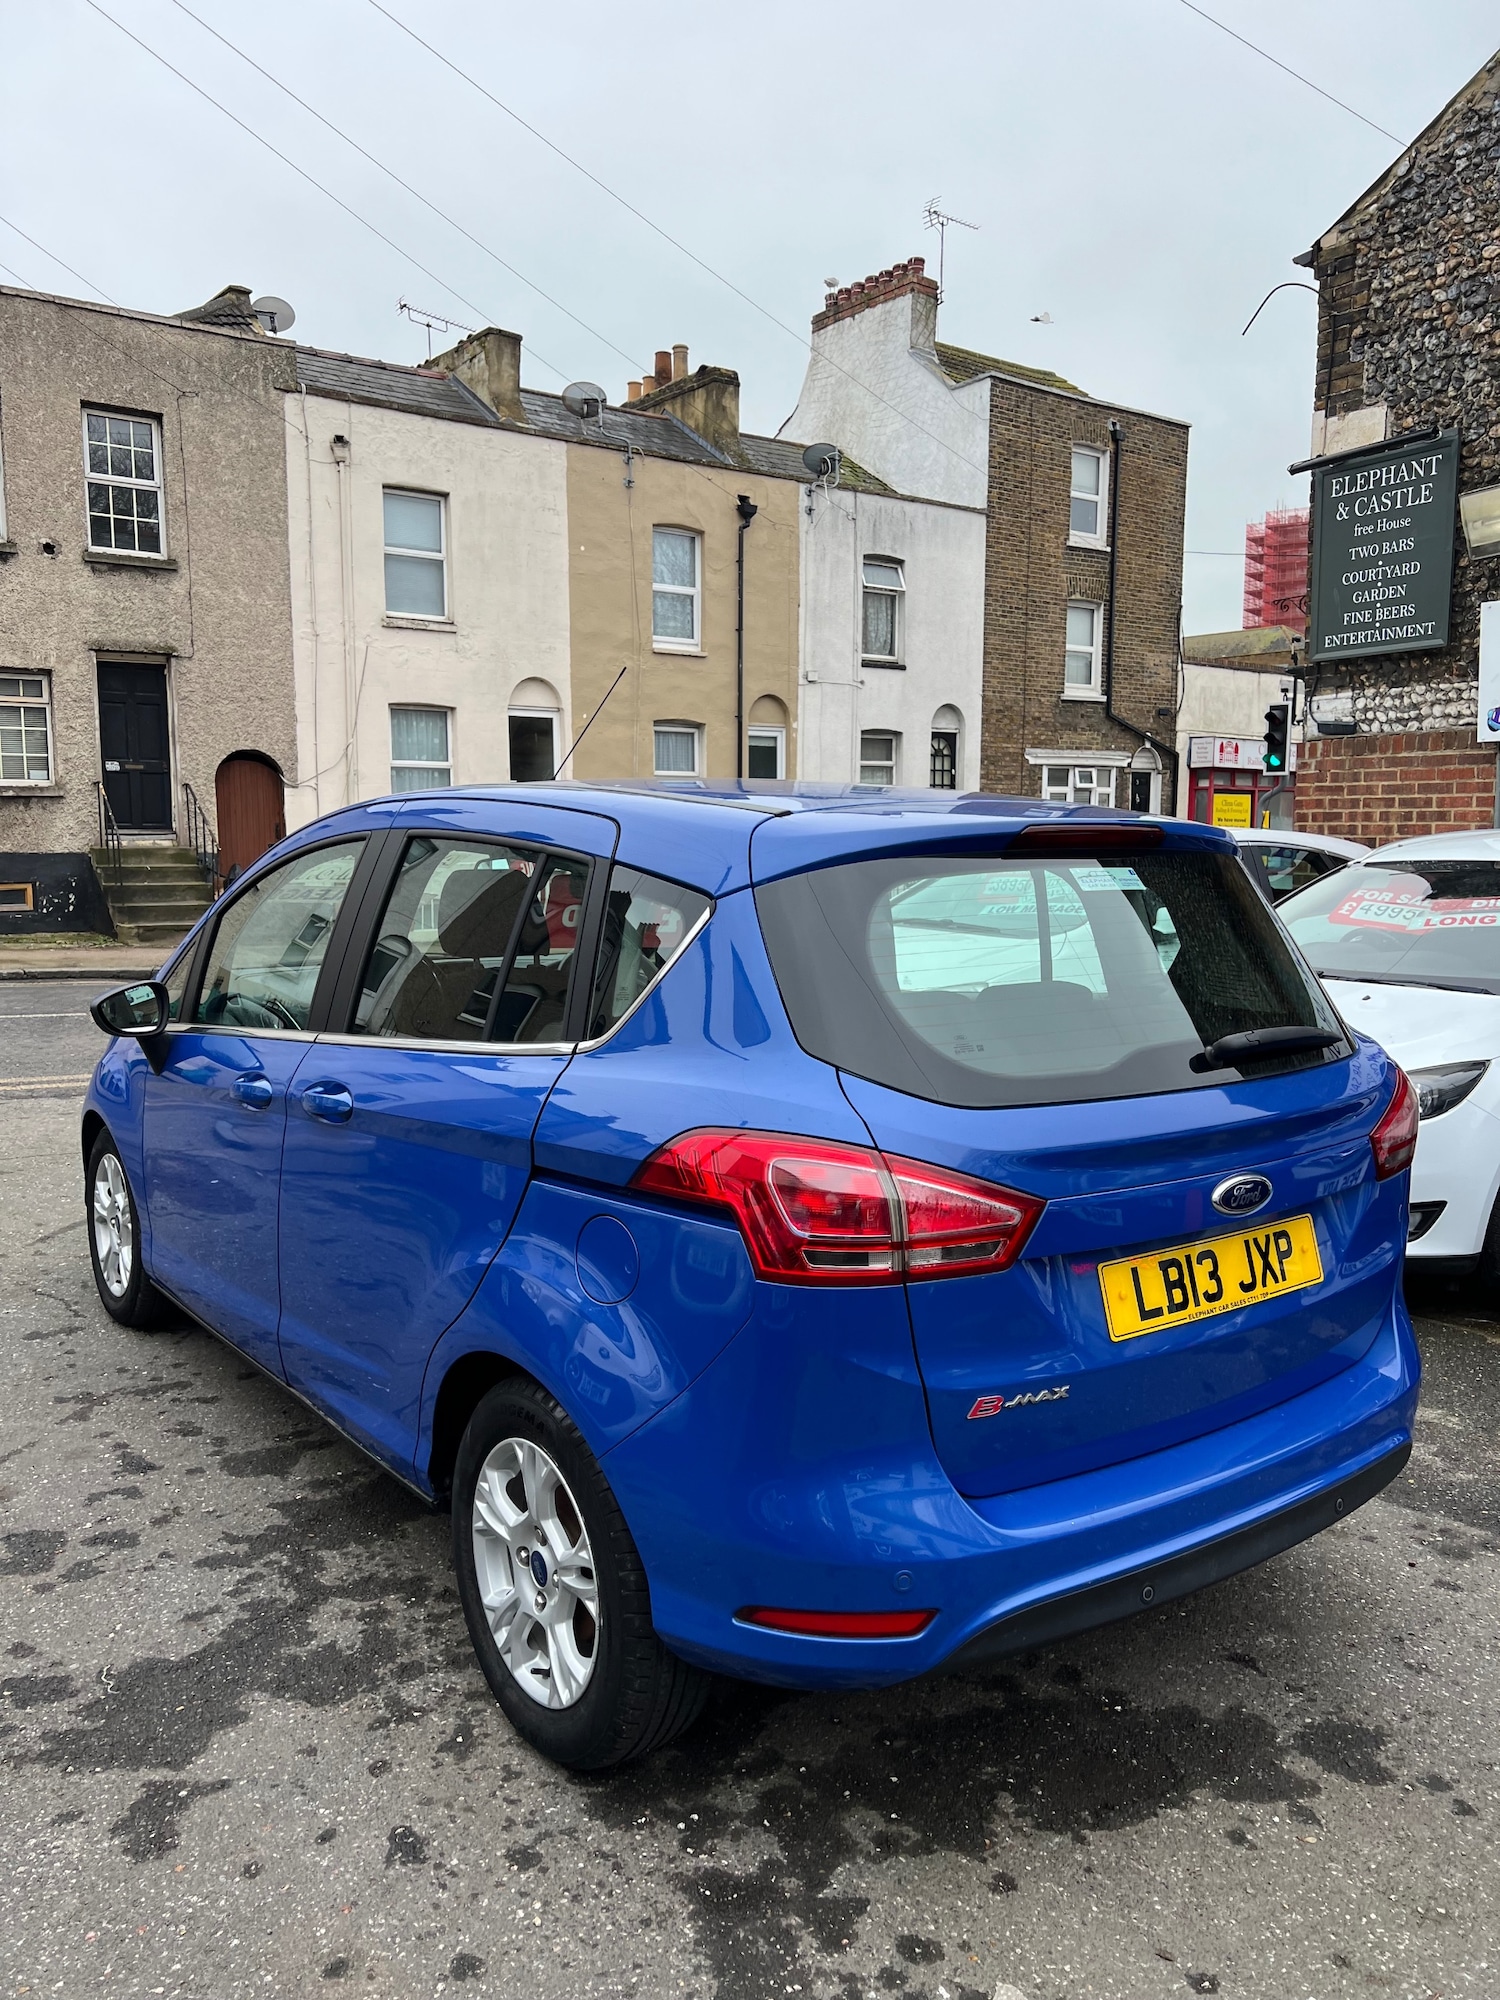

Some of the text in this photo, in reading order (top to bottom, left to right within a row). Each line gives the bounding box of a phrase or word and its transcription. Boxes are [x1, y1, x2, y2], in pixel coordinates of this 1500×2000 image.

[1330, 454, 1442, 498] ELEPHANT
[1336, 483, 1433, 521] & CASTLE
[1354, 517, 1411, 537] free House
[1349, 537, 1415, 561] TWO BARS
[1342, 561, 1421, 586] COURTYARD
[1352, 584, 1407, 604] GARDEN
[1343, 604, 1416, 626] FINE BEERS
[1324, 622, 1436, 648] ENTERTAINMENT
[987, 904, 1084, 914] LOW MIEAGE
[1352, 889, 1433, 908] FOR SAL
[1471, 899, 1500, 908] DI
[1359, 903, 1416, 920] 4995
[1423, 915, 1498, 928] LONG
[1230, 1182, 1262, 1207] Ford
[1130, 1229, 1293, 1323] LB13 JXP
[1188, 1307, 1217, 1320] ELEPHANT
[1219, 1303, 1230, 1312] CAR
[1231, 1299, 1247, 1308] SALES
